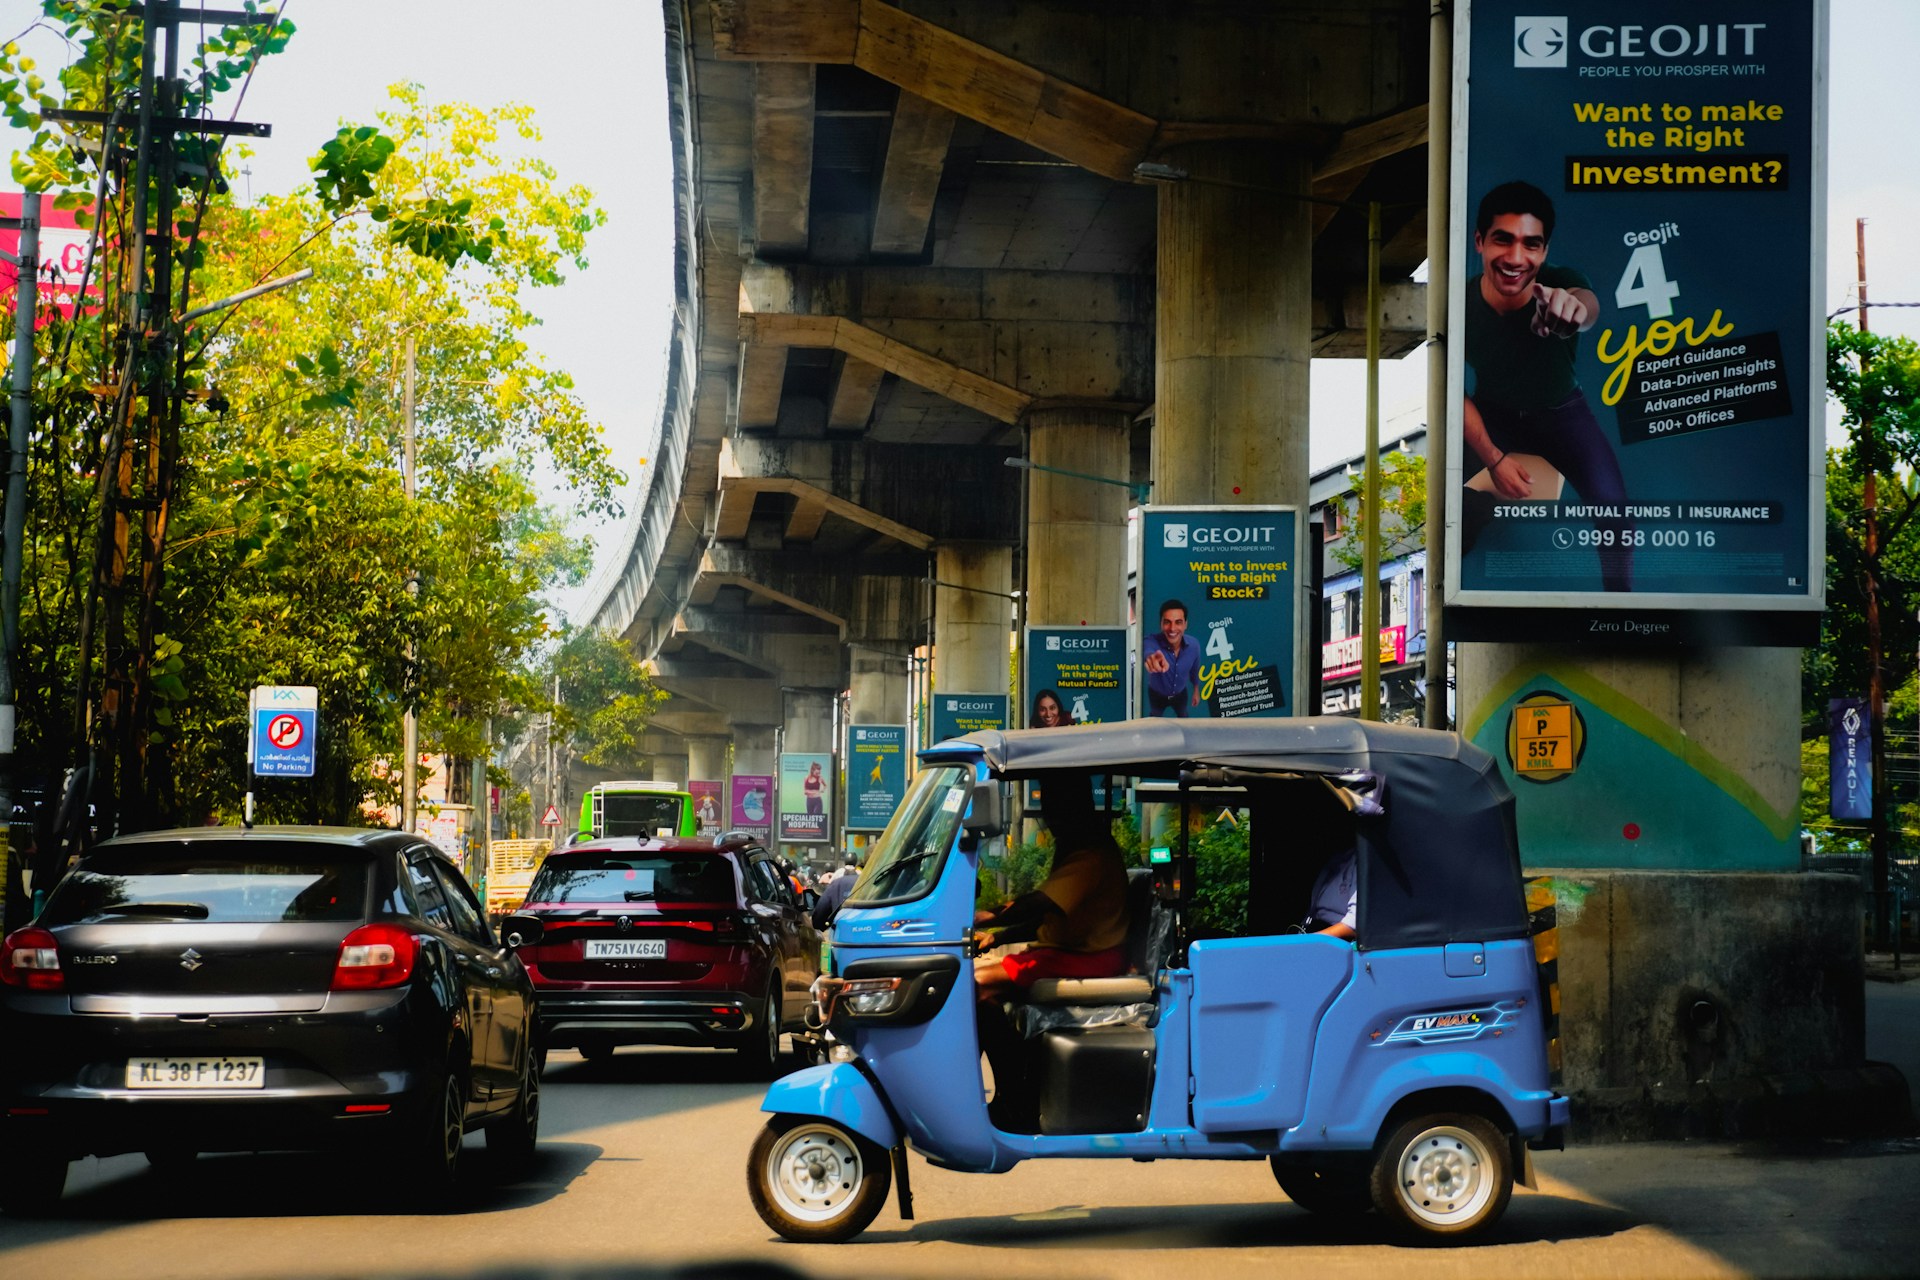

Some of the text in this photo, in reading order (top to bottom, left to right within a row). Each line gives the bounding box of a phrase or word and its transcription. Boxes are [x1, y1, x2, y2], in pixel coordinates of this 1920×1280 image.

[1579, 23, 1766, 58] GEOJIT
[1579, 64, 1765, 77] PEOPLE YOU PROSPER WITH
[1573, 100, 1784, 123] Want to make
[1605, 125, 1745, 152] the Right
[1572, 160, 1782, 185] Investment?
[1623, 221, 1680, 247] Geojit
[1614, 243, 1680, 320] 4
[1597, 308, 1735, 406] you
[1637, 344, 1746, 374] Expert Guidance
[1640, 358, 1776, 393] Data-Driven Insights
[1644, 380, 1777, 414] Advanced Platforms
[1649, 409, 1735, 434] 500+ Offices
[1493, 505, 1769, 519] STOCKS MUTUAL FUNDS INSURANCE
[1192, 527, 1276, 543] GEOJIT
[1578, 530, 1716, 547] 999 58 000 16
[1189, 560, 1288, 572] Want to invest
[1197, 572, 1277, 585] in the Right
[1211, 586, 1264, 599] Stock?
[1208, 617, 1233, 629] Geojit
[1589, 620, 1670, 635] Zero Degree
[1062, 639, 1109, 649] GEOJIT
[1205, 627, 1234, 661] 4
[1089, 671, 1112, 679] Right
[1093, 663, 1119, 671] invest
[1198, 655, 1258, 700] you
[1214, 671, 1263, 686] Expert Guidance
[1217, 679, 1269, 694] Portfolio Analyser
[1218, 687, 1269, 704] Research-backed
[1220, 693, 1273, 709] Recommendations
[1071, 700, 1089, 721] 4
[1226, 706, 1251, 717] Decades
[1259, 701, 1275, 710] Trust
[1537, 720, 1547, 735] P
[1529, 740, 1558, 757] 557
[277, 763, 307, 772] Parking
[1527, 759, 1554, 768] KMRL
[1847, 738, 1857, 809] RENAULT
[783, 814, 825, 822] SPECIALISTS'
[594, 943, 664, 955] TN75AV4640
[73, 955, 118, 965] BALENO
[140, 1061, 259, 1082] KL 38 F 1237
